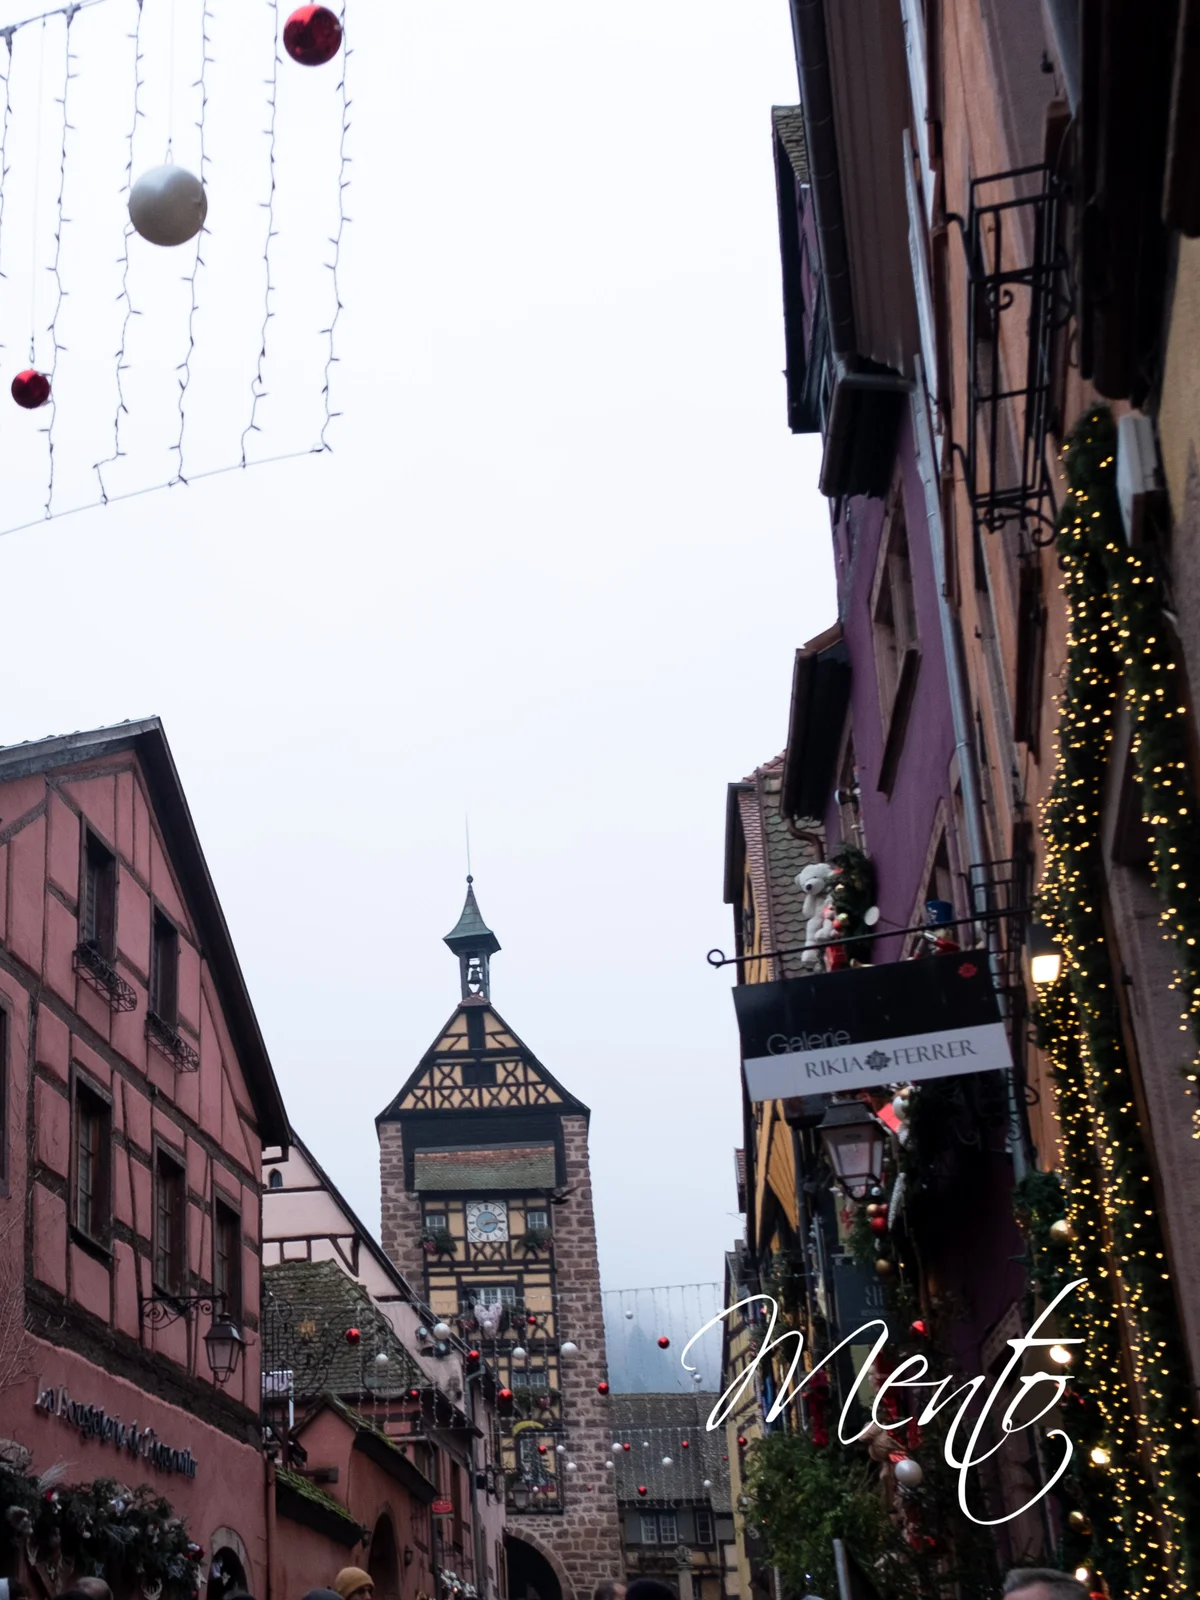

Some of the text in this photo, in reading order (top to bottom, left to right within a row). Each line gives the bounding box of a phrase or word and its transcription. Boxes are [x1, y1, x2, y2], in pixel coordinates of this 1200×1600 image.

[766, 1028, 851, 1055] Galerie
[805, 1039, 979, 1078] RIKIA FERRER
